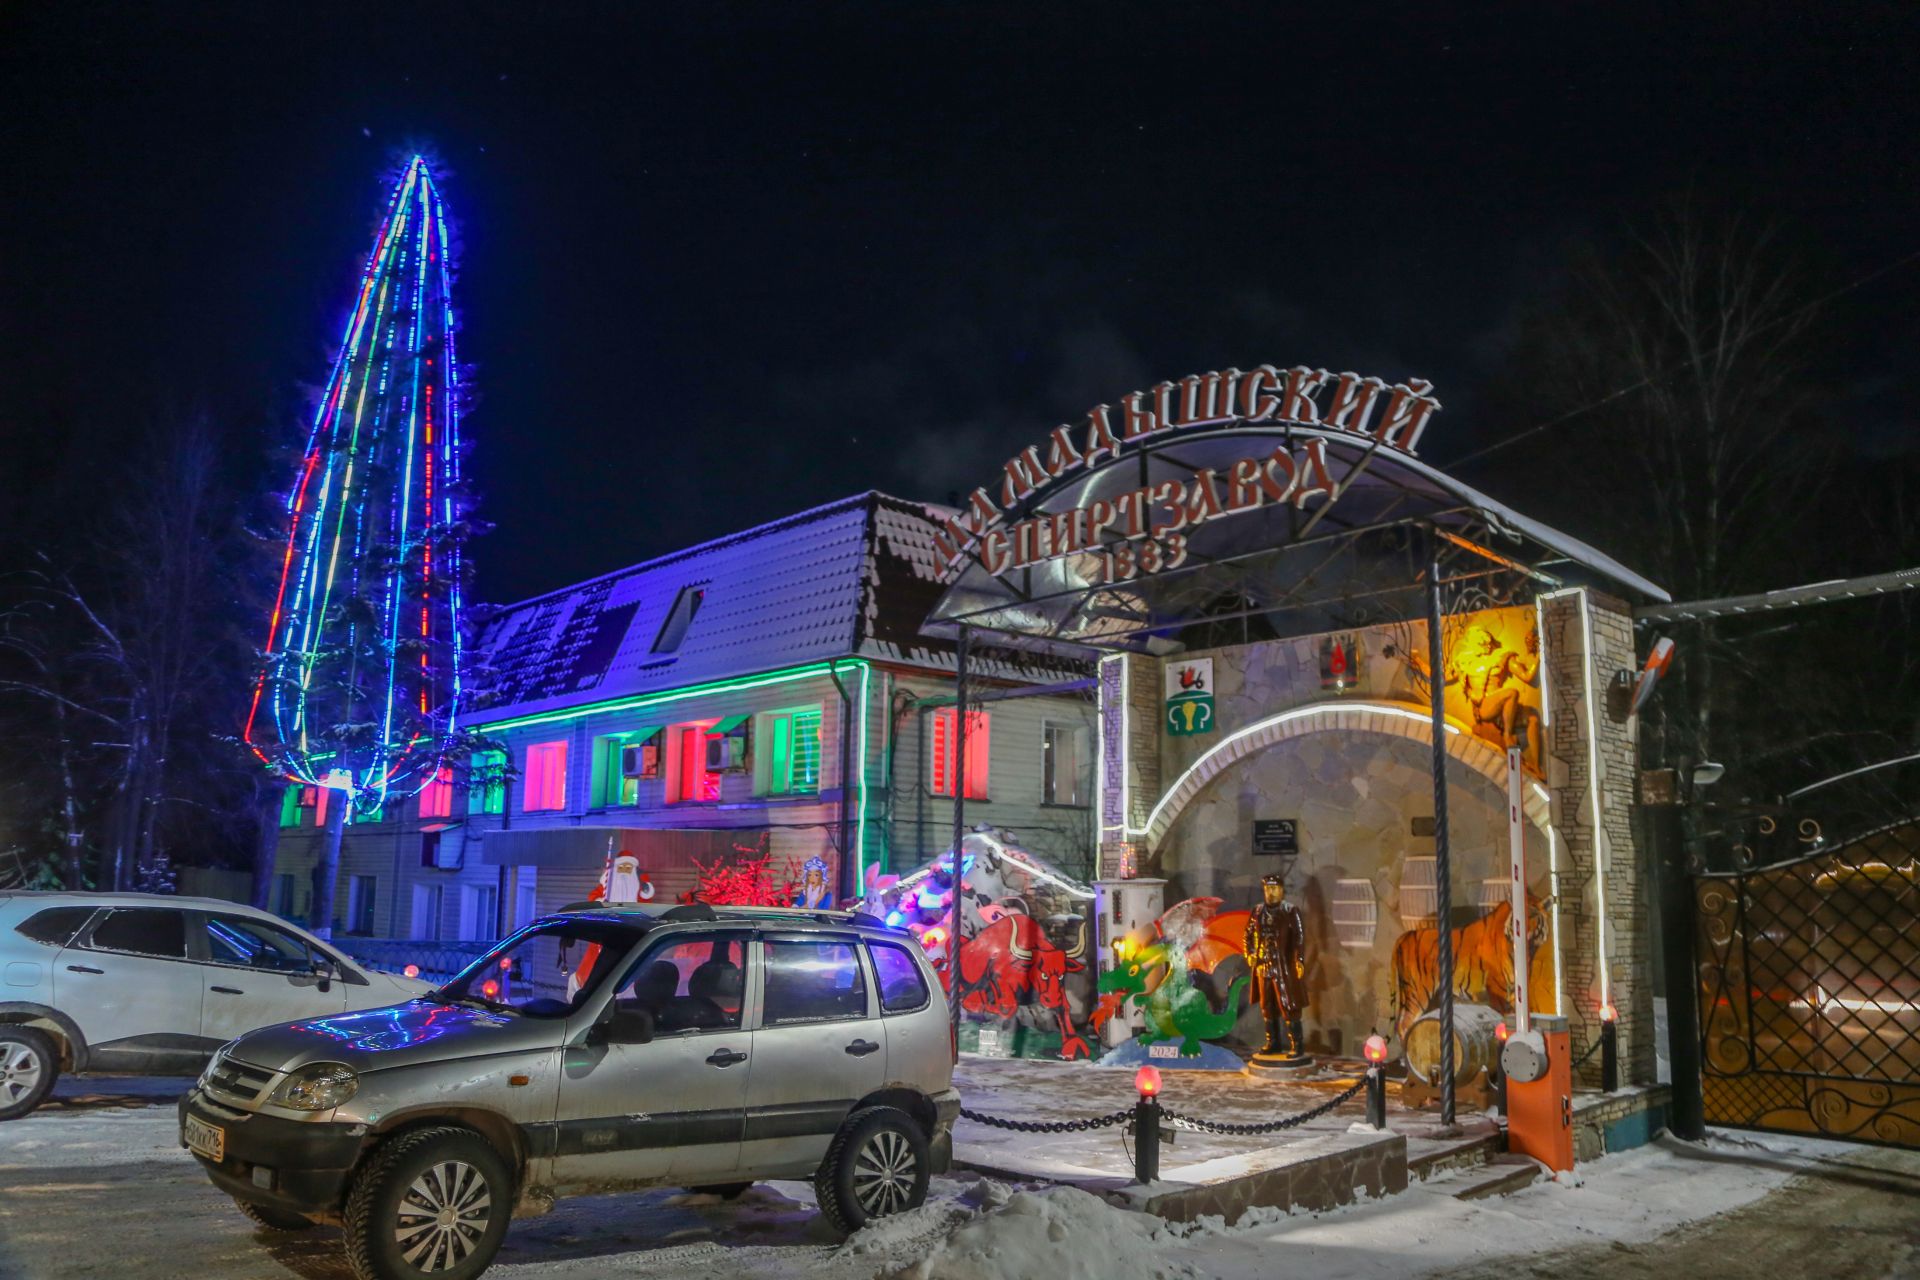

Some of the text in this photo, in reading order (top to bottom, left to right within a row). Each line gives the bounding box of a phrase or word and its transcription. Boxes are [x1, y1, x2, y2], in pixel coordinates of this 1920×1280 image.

[931, 364, 1442, 577] МАМАДЫШСКИЙ
[980, 436, 1339, 577] СПИРТЗАВОД
[1102, 533, 1187, 584] 1883
[1150, 1046, 1177, 1058] 2024
